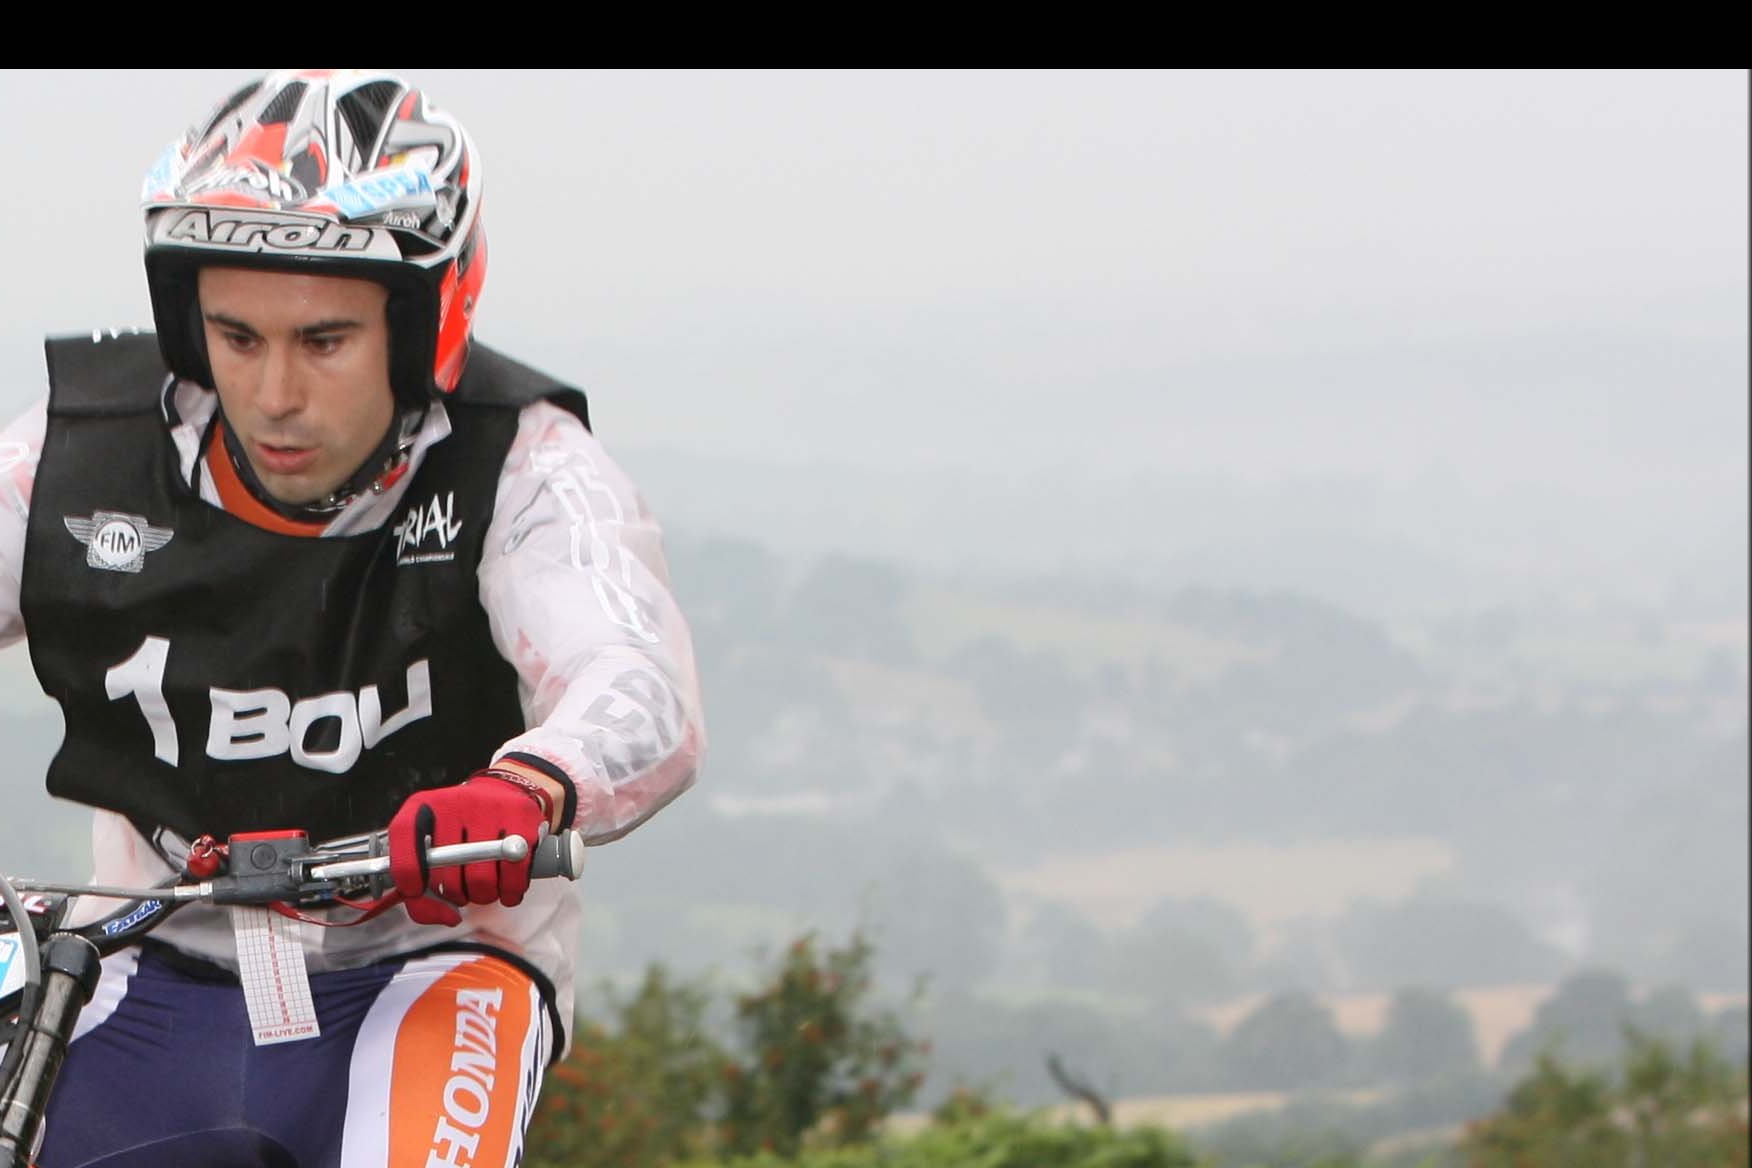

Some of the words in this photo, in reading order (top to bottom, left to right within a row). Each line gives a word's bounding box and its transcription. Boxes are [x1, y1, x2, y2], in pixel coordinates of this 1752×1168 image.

[165, 208, 375, 252] Airoh
[100, 530, 136, 554] FIM
[393, 489, 463, 562] TRIAL
[105, 635, 179, 768] 1
[205, 658, 432, 774] BOU
